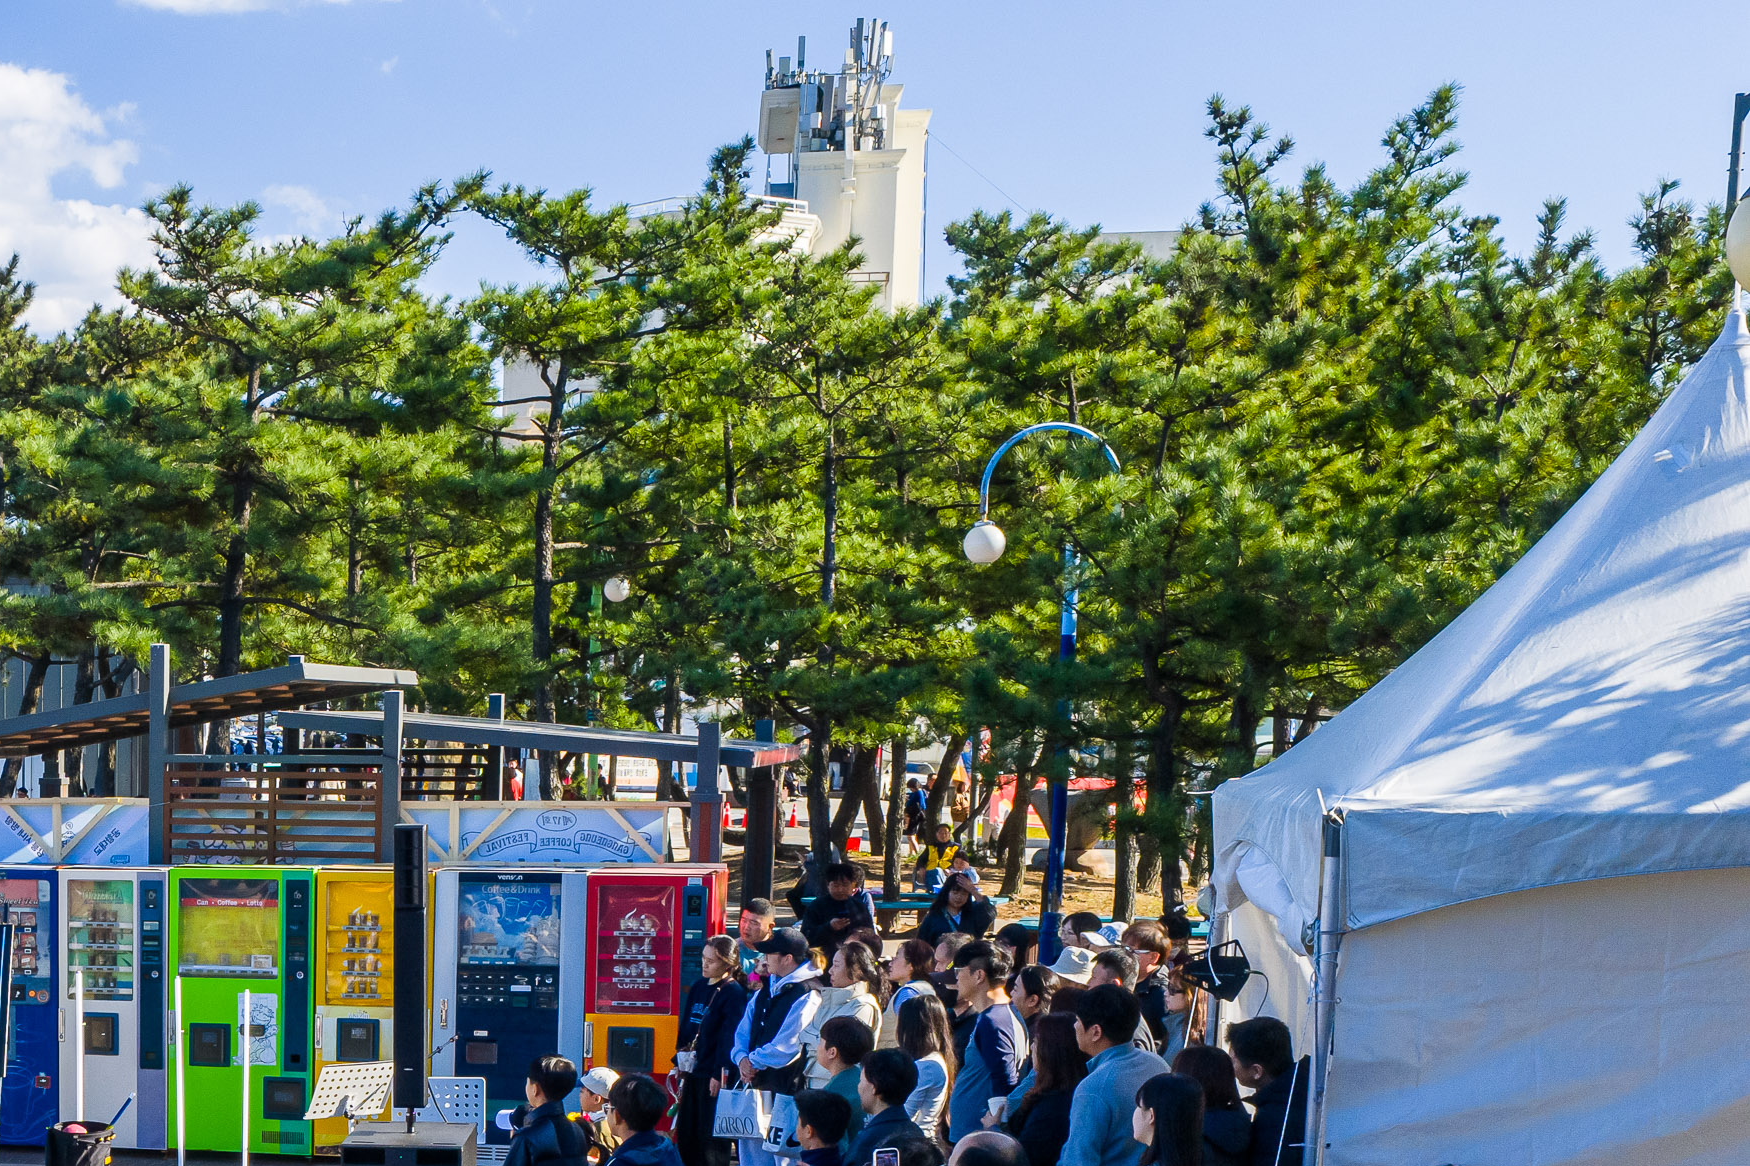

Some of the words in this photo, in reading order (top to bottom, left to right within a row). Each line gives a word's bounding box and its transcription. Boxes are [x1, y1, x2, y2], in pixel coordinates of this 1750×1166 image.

[196, 899, 209, 907] Can
[217, 899, 238, 907] Coffee
[617, 982, 650, 990] COFFEE
